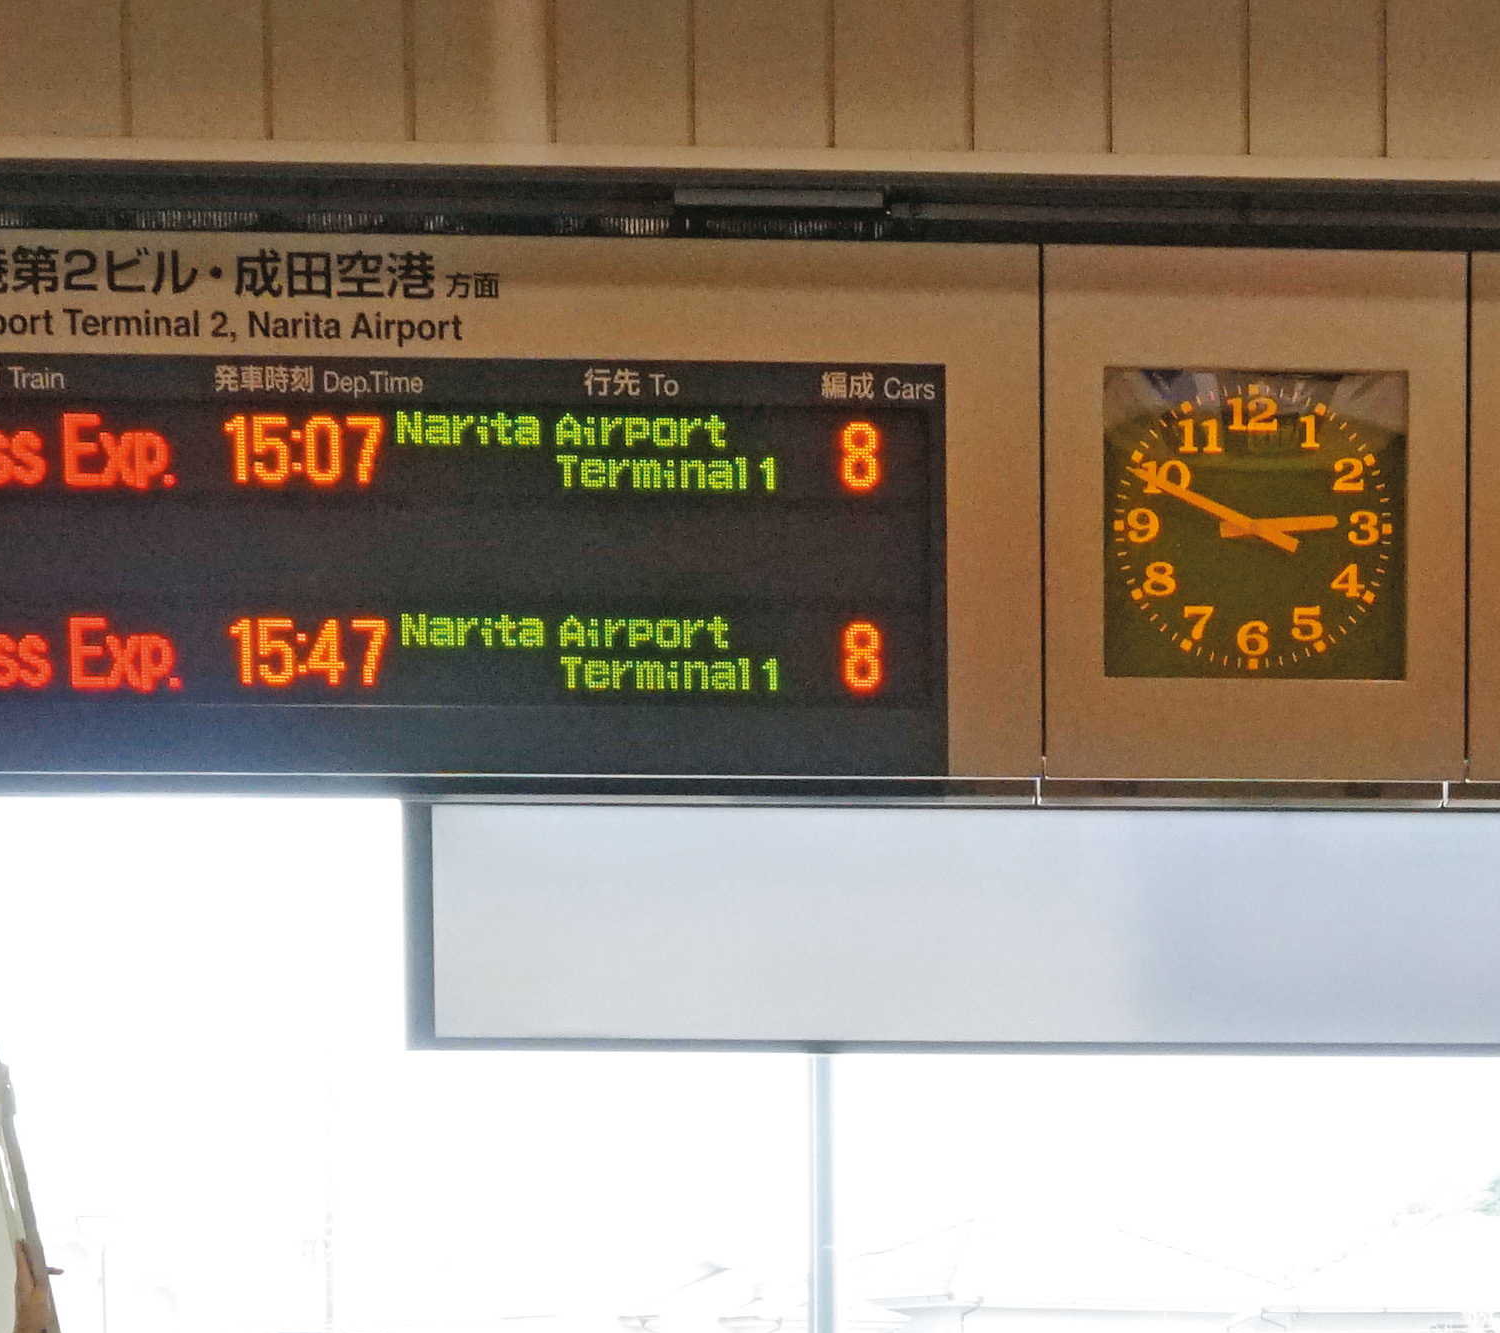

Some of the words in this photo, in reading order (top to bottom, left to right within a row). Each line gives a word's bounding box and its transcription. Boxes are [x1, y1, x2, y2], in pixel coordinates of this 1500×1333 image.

[445, 271, 500, 300] 方面
[62, 309, 200, 338] Terminal
[210, 312, 238, 343] 2,
[249, 311, 341, 340] Narita
[351, 313, 463, 346] Airport
[7, 367, 65, 391] Train
[214, 366, 315, 393] 発車時刻
[323, 370, 423, 398] Dep.Time
[584, 368, 642, 397] 行先
[650, 373, 679, 397] To
[821, 372, 875, 400] 編成
[884, 377, 936, 400] Cars
[1228, 397, 1277, 431] 12
[1178, 418, 1222, 453] 11
[1300, 415, 1320, 449] 1
[62, 412, 177, 488] Exp.
[224, 414, 383, 485] 15:07
[396, 410, 542, 445] Narita
[555, 413, 727, 450] Airport
[842, 422, 878, 490] 8
[556, 455, 748, 491] Terminal
[760, 457, 776, 491] 1
[1139, 460, 1191, 494] 10
[1333, 457, 1364, 491] 2
[1127, 507, 1159, 542] 9
[1348, 511, 1379, 545] 3
[1143, 561, 1176, 597] 8
[1331, 563, 1363, 598] 4
[1183, 605, 1213, 640] 7
[1237, 621, 1269, 656] 6
[1291, 605, 1323, 641] 5
[69, 616, 183, 691] Exp.
[230, 618, 389, 685] 15:47
[400, 613, 545, 648] Narita
[559, 615, 730, 652] Airport
[844, 623, 881, 690] 8
[560, 656, 750, 691] Terminal
[763, 657, 779, 691] 1
